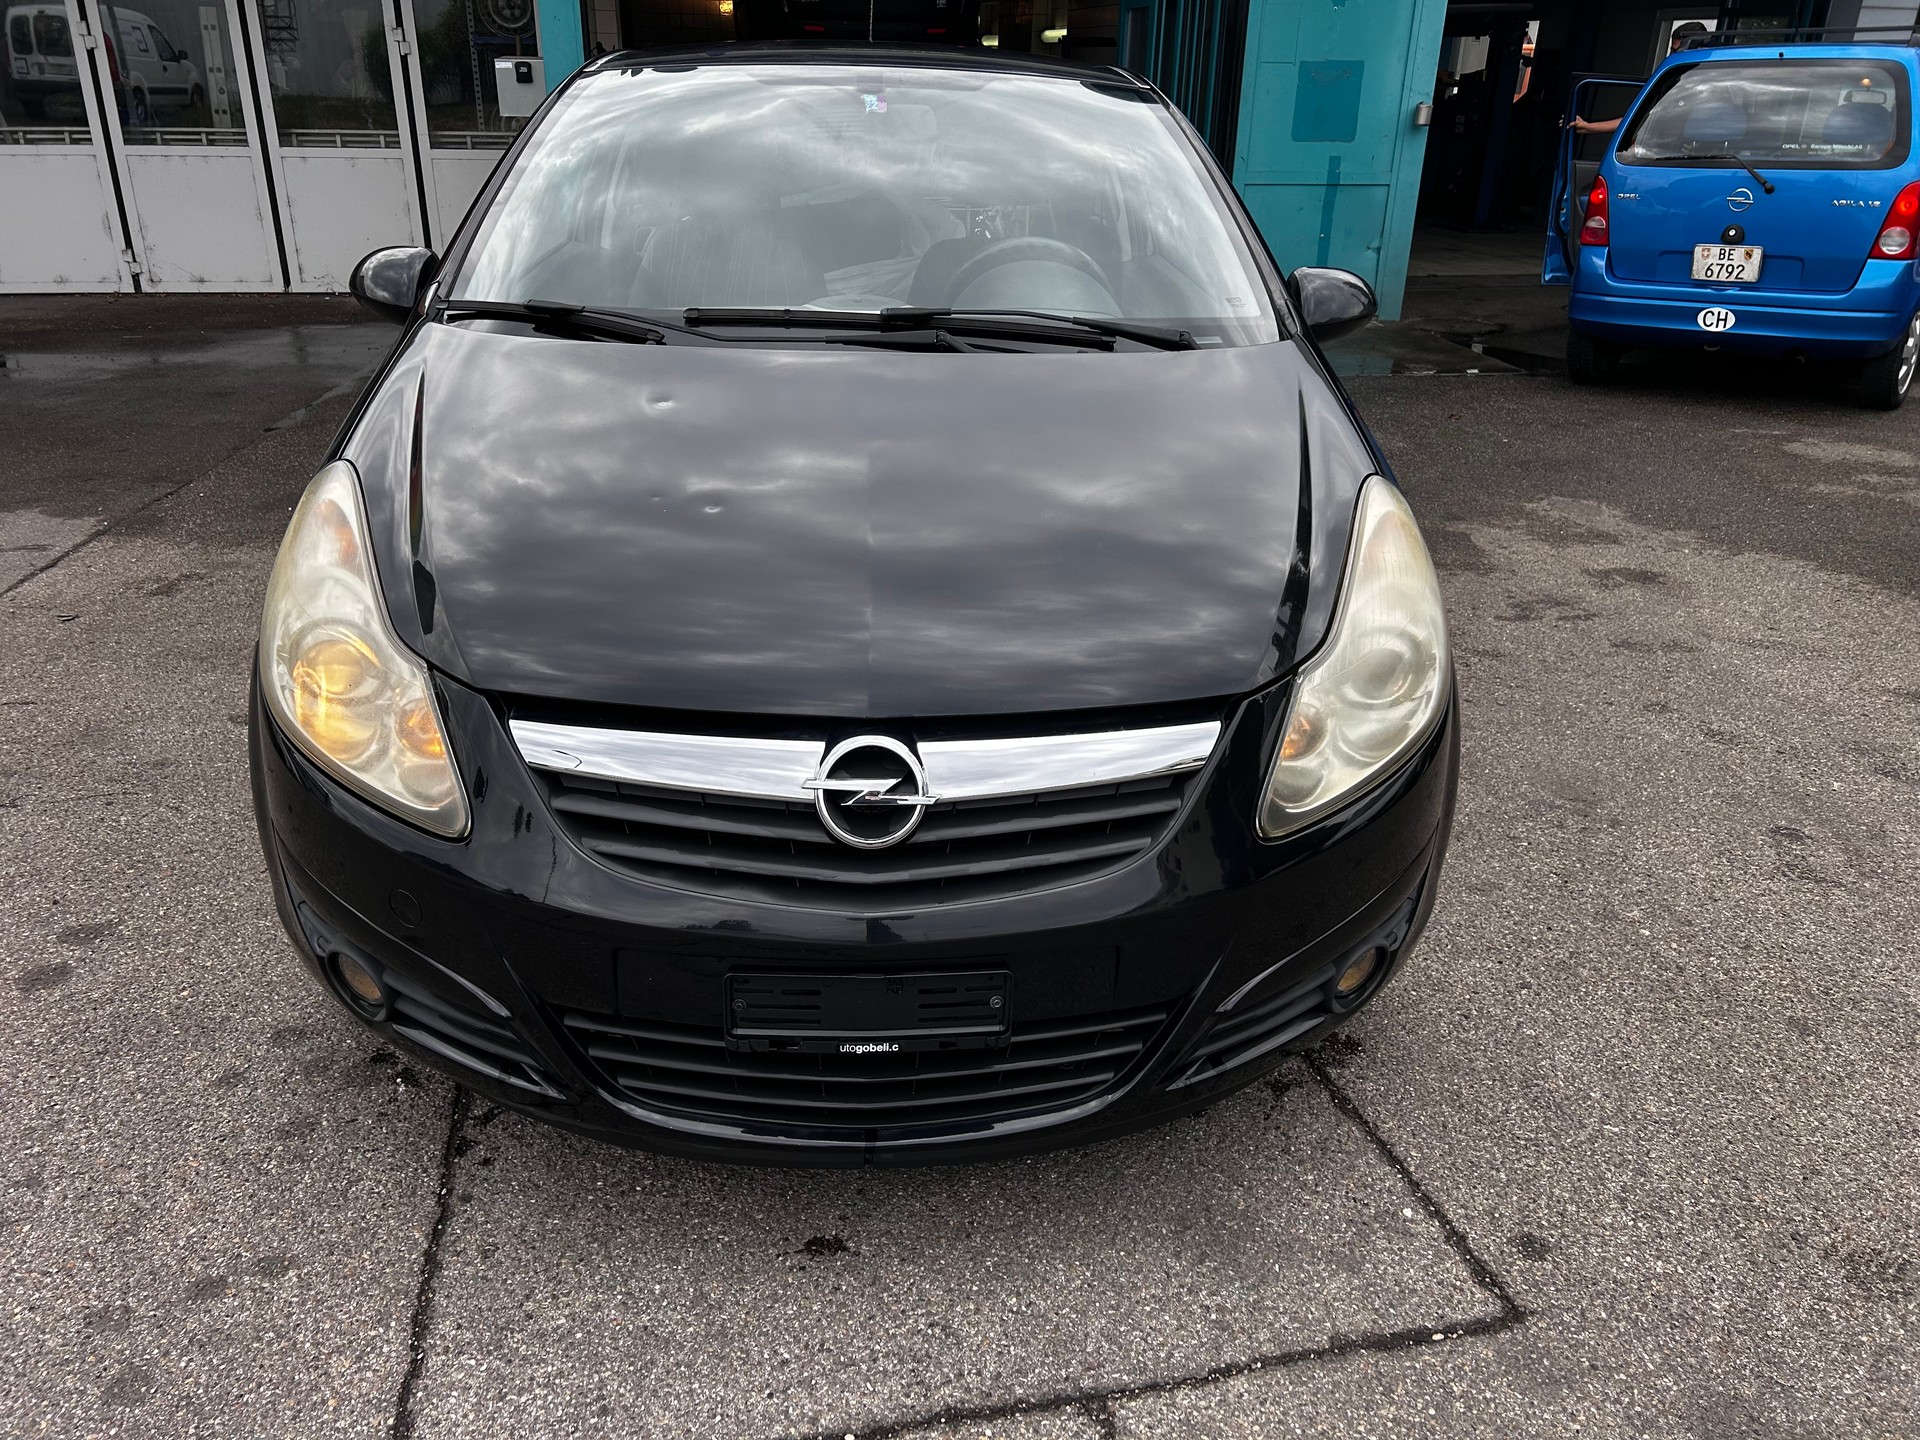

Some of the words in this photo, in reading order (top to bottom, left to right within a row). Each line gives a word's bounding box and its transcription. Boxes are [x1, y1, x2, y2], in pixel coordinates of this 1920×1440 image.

[1718, 248, 1736, 261] BE
[1704, 262, 1745, 280] 6792
[1702, 310, 1728, 328] CH
